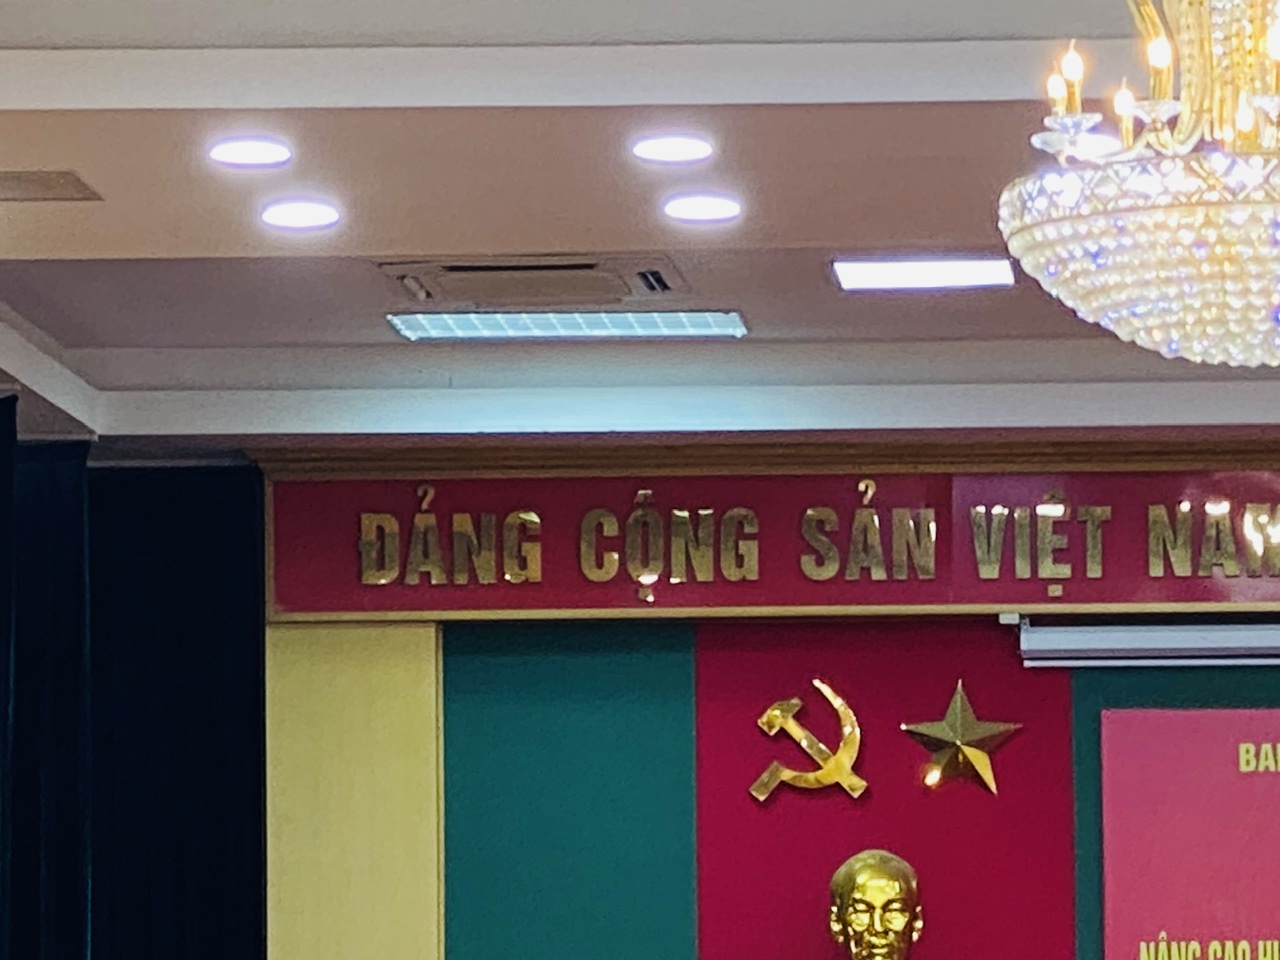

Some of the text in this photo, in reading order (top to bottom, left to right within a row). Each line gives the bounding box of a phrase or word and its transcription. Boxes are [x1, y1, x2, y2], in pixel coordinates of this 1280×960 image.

[358, 485, 542, 585] ĐẢNG
[579, 488, 760, 602] CỘNG
[800, 479, 936, 582] SẢN
[970, 490, 1112, 597] VIỆT
